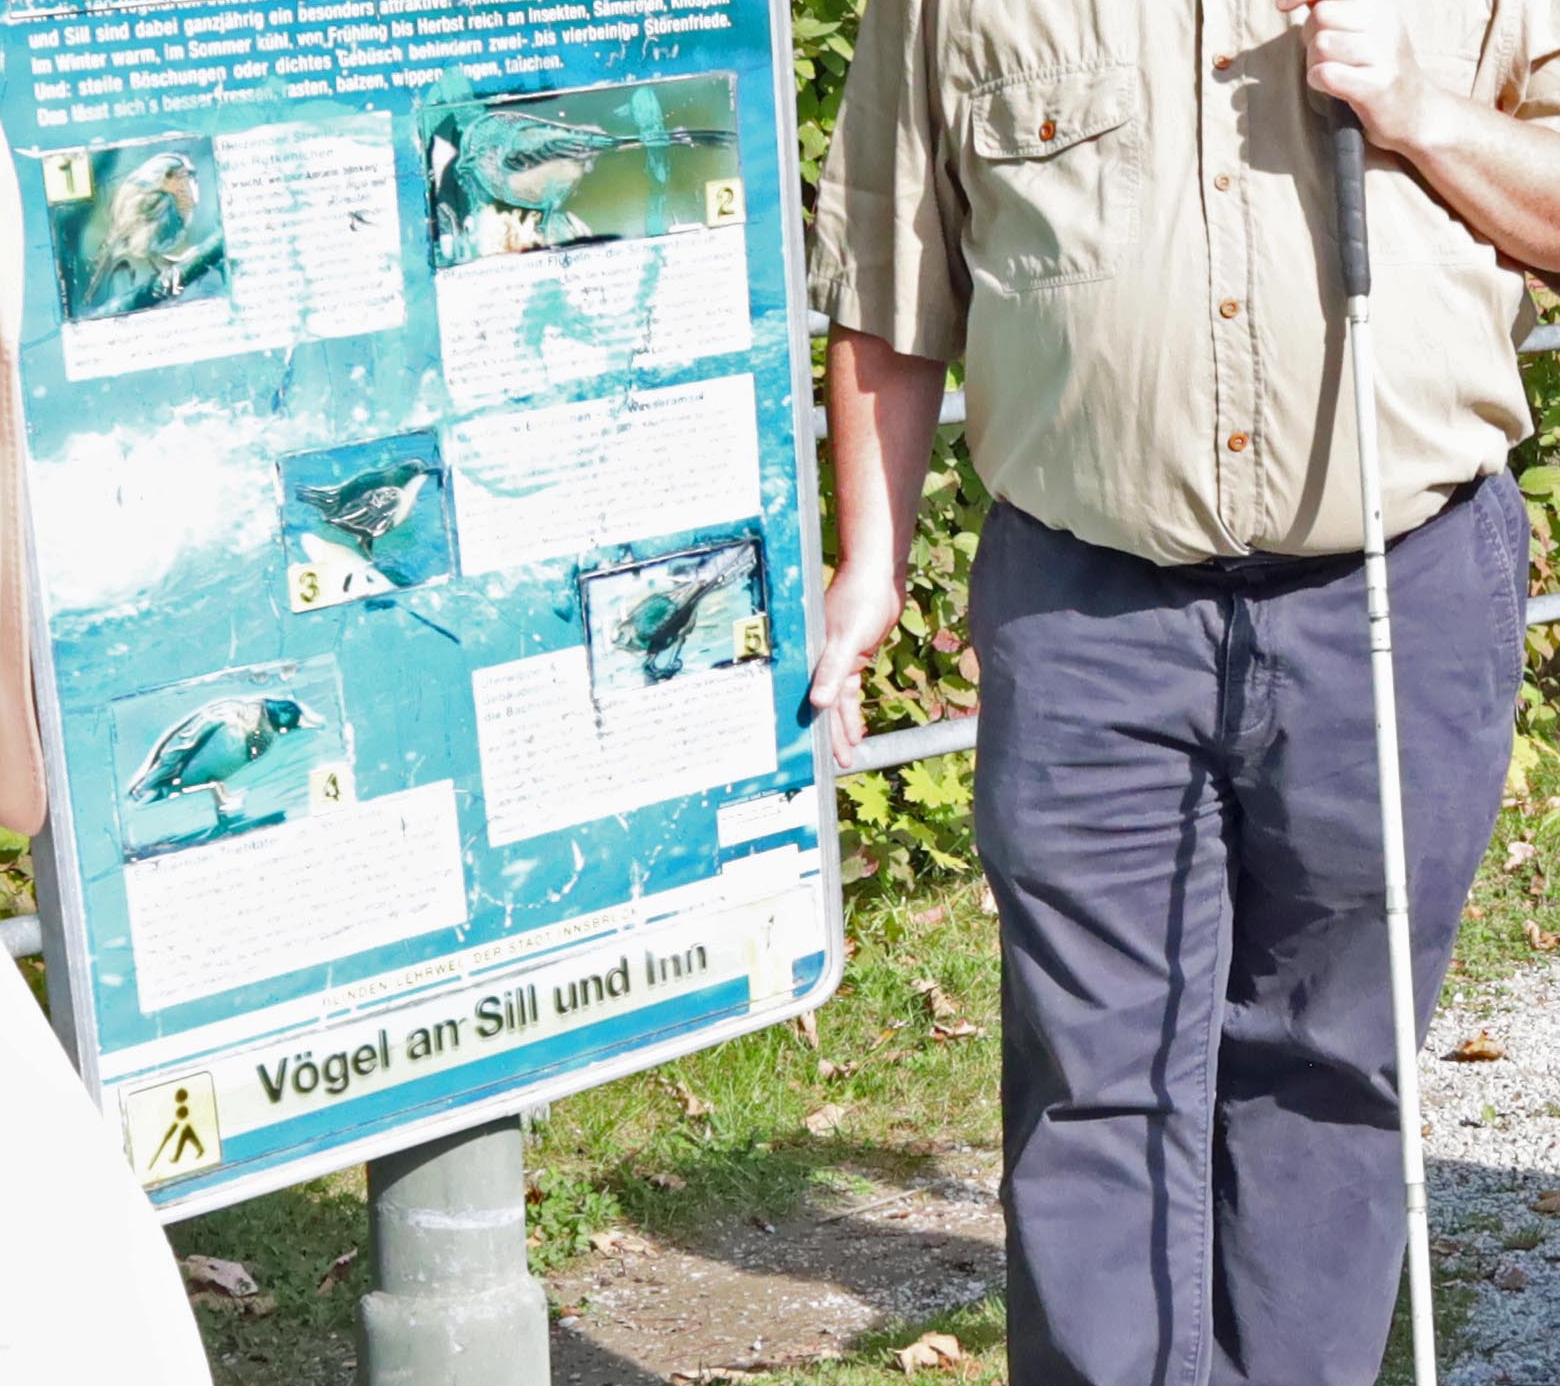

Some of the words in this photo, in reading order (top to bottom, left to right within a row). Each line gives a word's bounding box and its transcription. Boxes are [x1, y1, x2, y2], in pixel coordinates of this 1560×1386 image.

[28, 29, 59, 49] und
[63, 25, 91, 46] Sill
[95, 22, 130, 42] sind
[135, 17, 178, 39] dabei
[183, 9, 264, 38] ganzjährig
[268, 8, 293, 25] ein
[297, 0, 375, 23] besonders
[55, 52, 107, 72] Winter
[111, 47, 161, 66] warm,
[188, 37, 252, 60] Sommer
[297, 30, 323, 48] von
[328, 22, 388, 44] Frühling
[392, 20, 414, 38] bis
[417, 15, 465, 36] Herbst
[468, 11, 504, 30] reich
[507, 10, 525, 26] an
[528, 2, 591, 24] Insekten,
[78, 74, 123, 97] steile
[129, 66, 227, 90] Böschungen
[233, 60, 269, 79] oder
[275, 53, 332, 75] dichtes
[337, 45, 403, 67] Gebüsch
[408, 38, 483, 60] behindern
[489, 31, 528, 52] zwei-
[534, 28, 557, 47] bis
[562, 21, 639, 44] vierbeinige
[644, 11, 731, 35] Störenfriede.
[336, 73, 389, 95] balzen,
[505, 53, 564, 75] tauchen.
[58, 159, 75, 194] 1
[716, 186, 736, 218] 2
[299, 571, 319, 603] 3
[743, 625, 763, 653] 5
[324, 772, 340, 801] 4
[256, 1029, 390, 1104] Vögel
[406, 1018, 460, 1061] an
[475, 984, 538, 1039] Sill
[555, 956, 630, 1015] und
[645, 944, 707, 986] Inn
